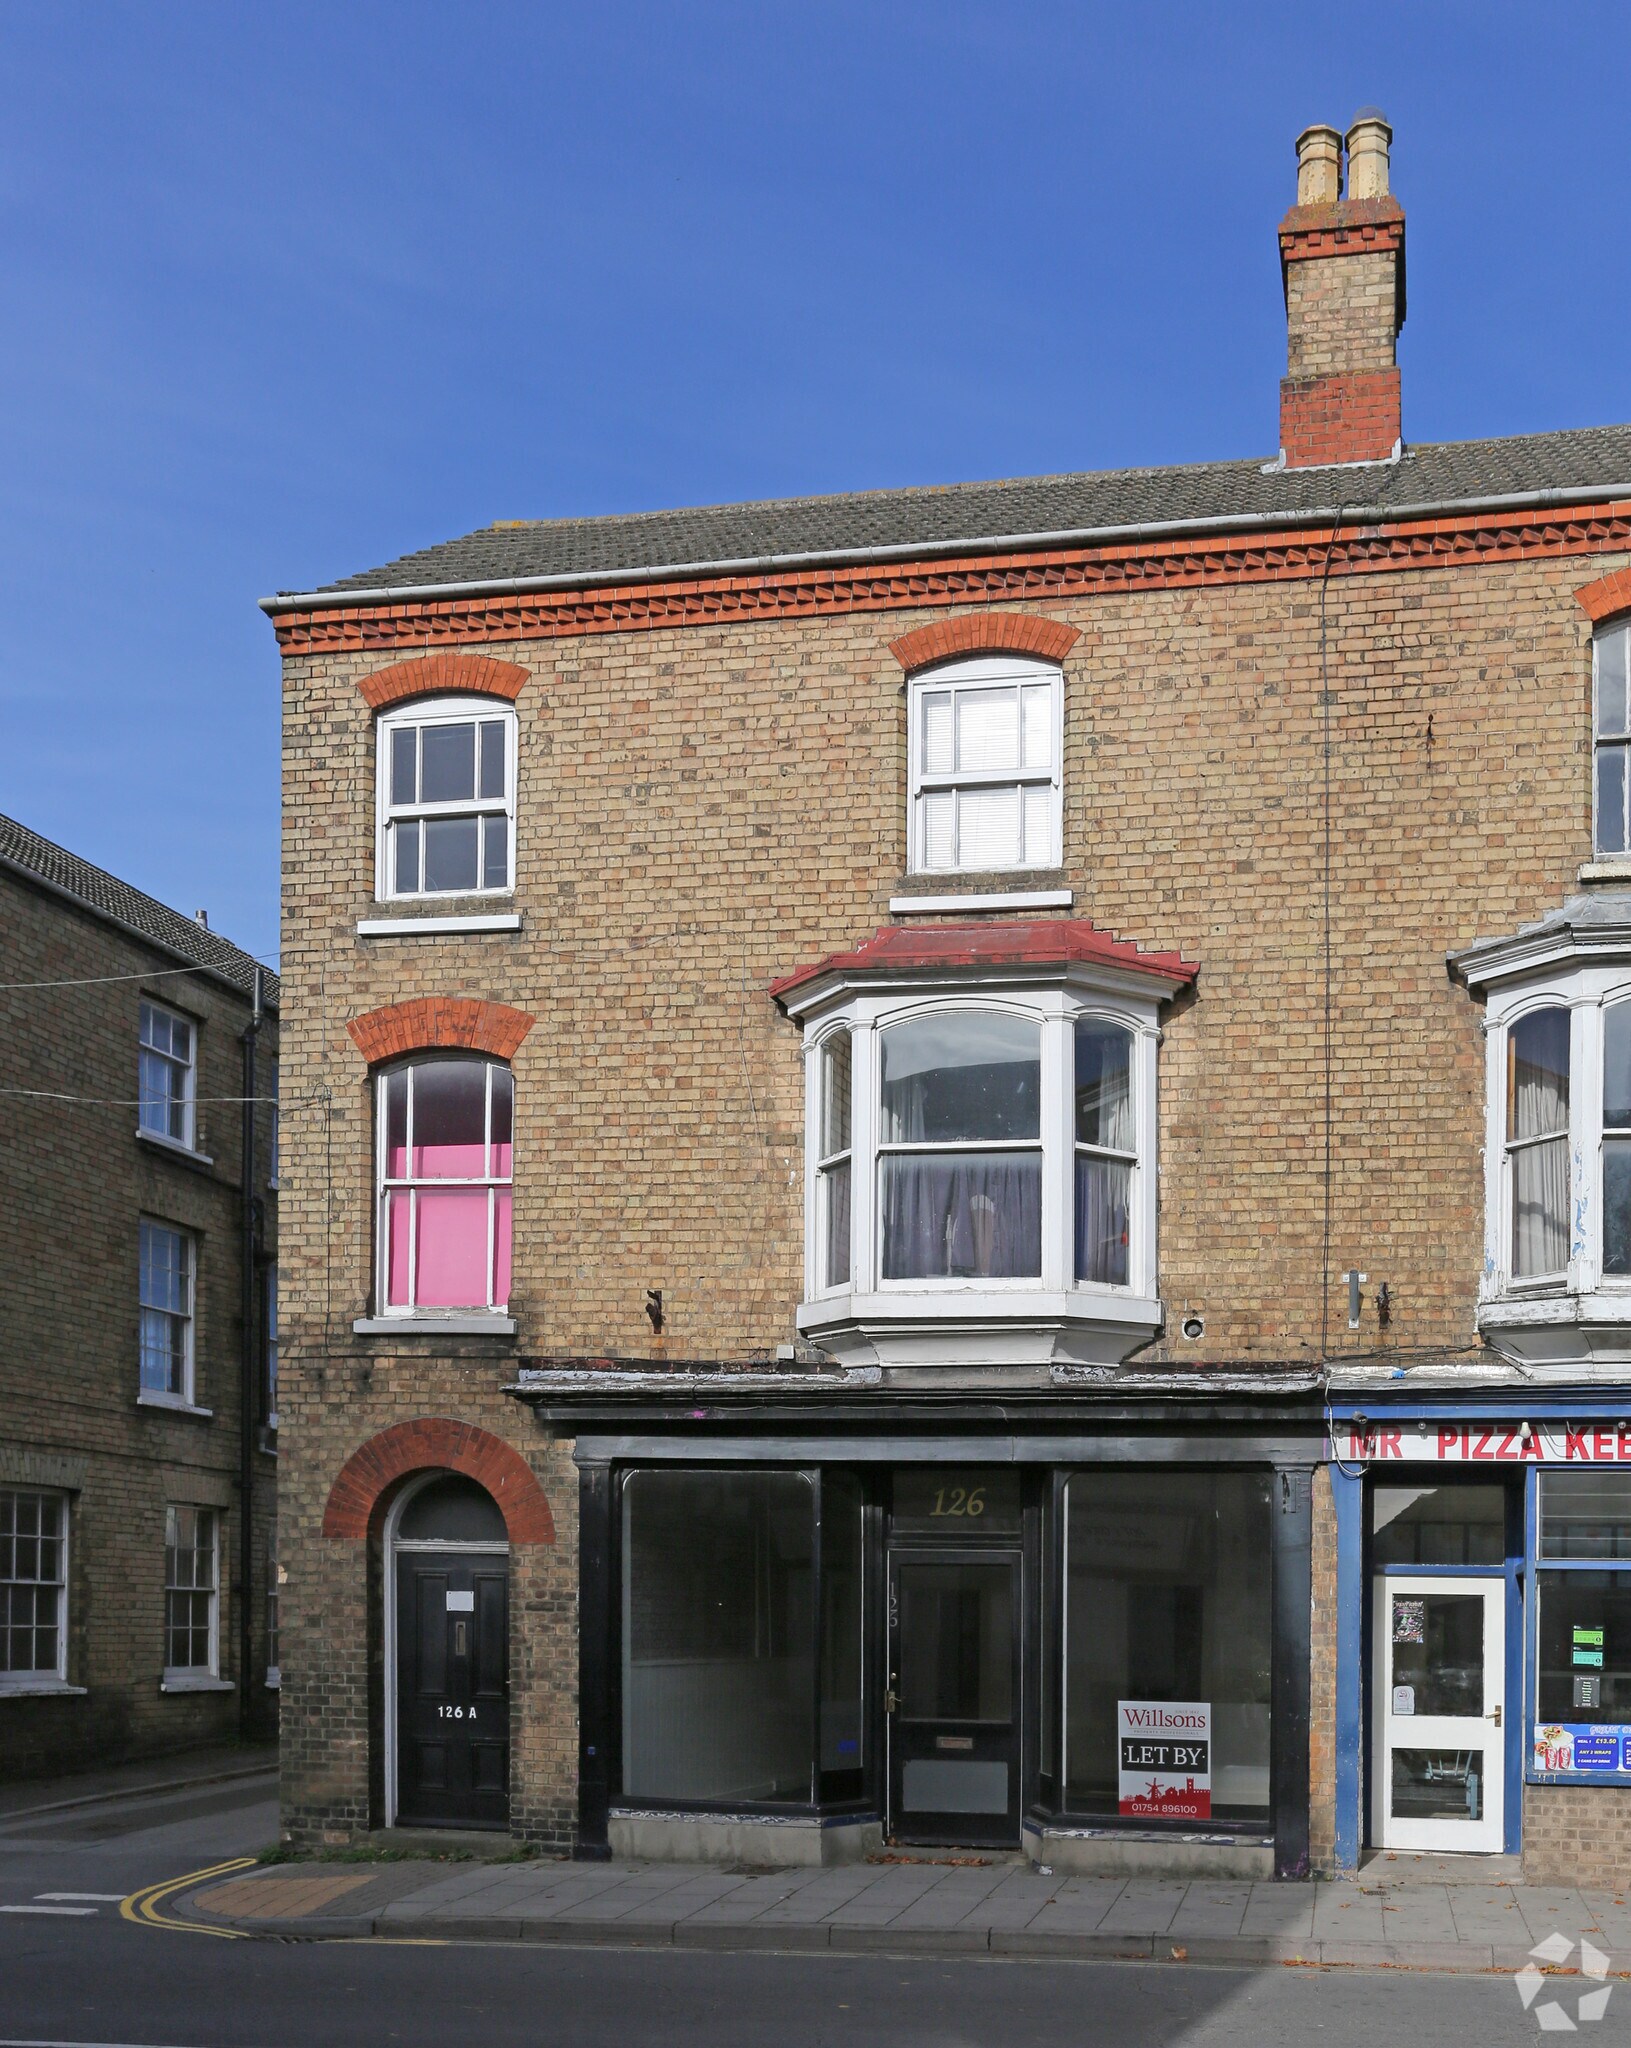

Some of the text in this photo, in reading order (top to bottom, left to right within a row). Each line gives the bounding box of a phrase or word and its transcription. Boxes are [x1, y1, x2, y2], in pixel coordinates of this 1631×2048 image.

[1349, 1425, 1404, 1460] MR
[1437, 1425, 1545, 1460] PIZZA
[928, 1487, 987, 1517] 126
[438, 1705, 477, 1719] 126 A
[1123, 1708, 1206, 1729] Willsons
[1126, 1745, 1203, 1766] LET BY
[1131, 1803, 1198, 1814] 01754 896100
